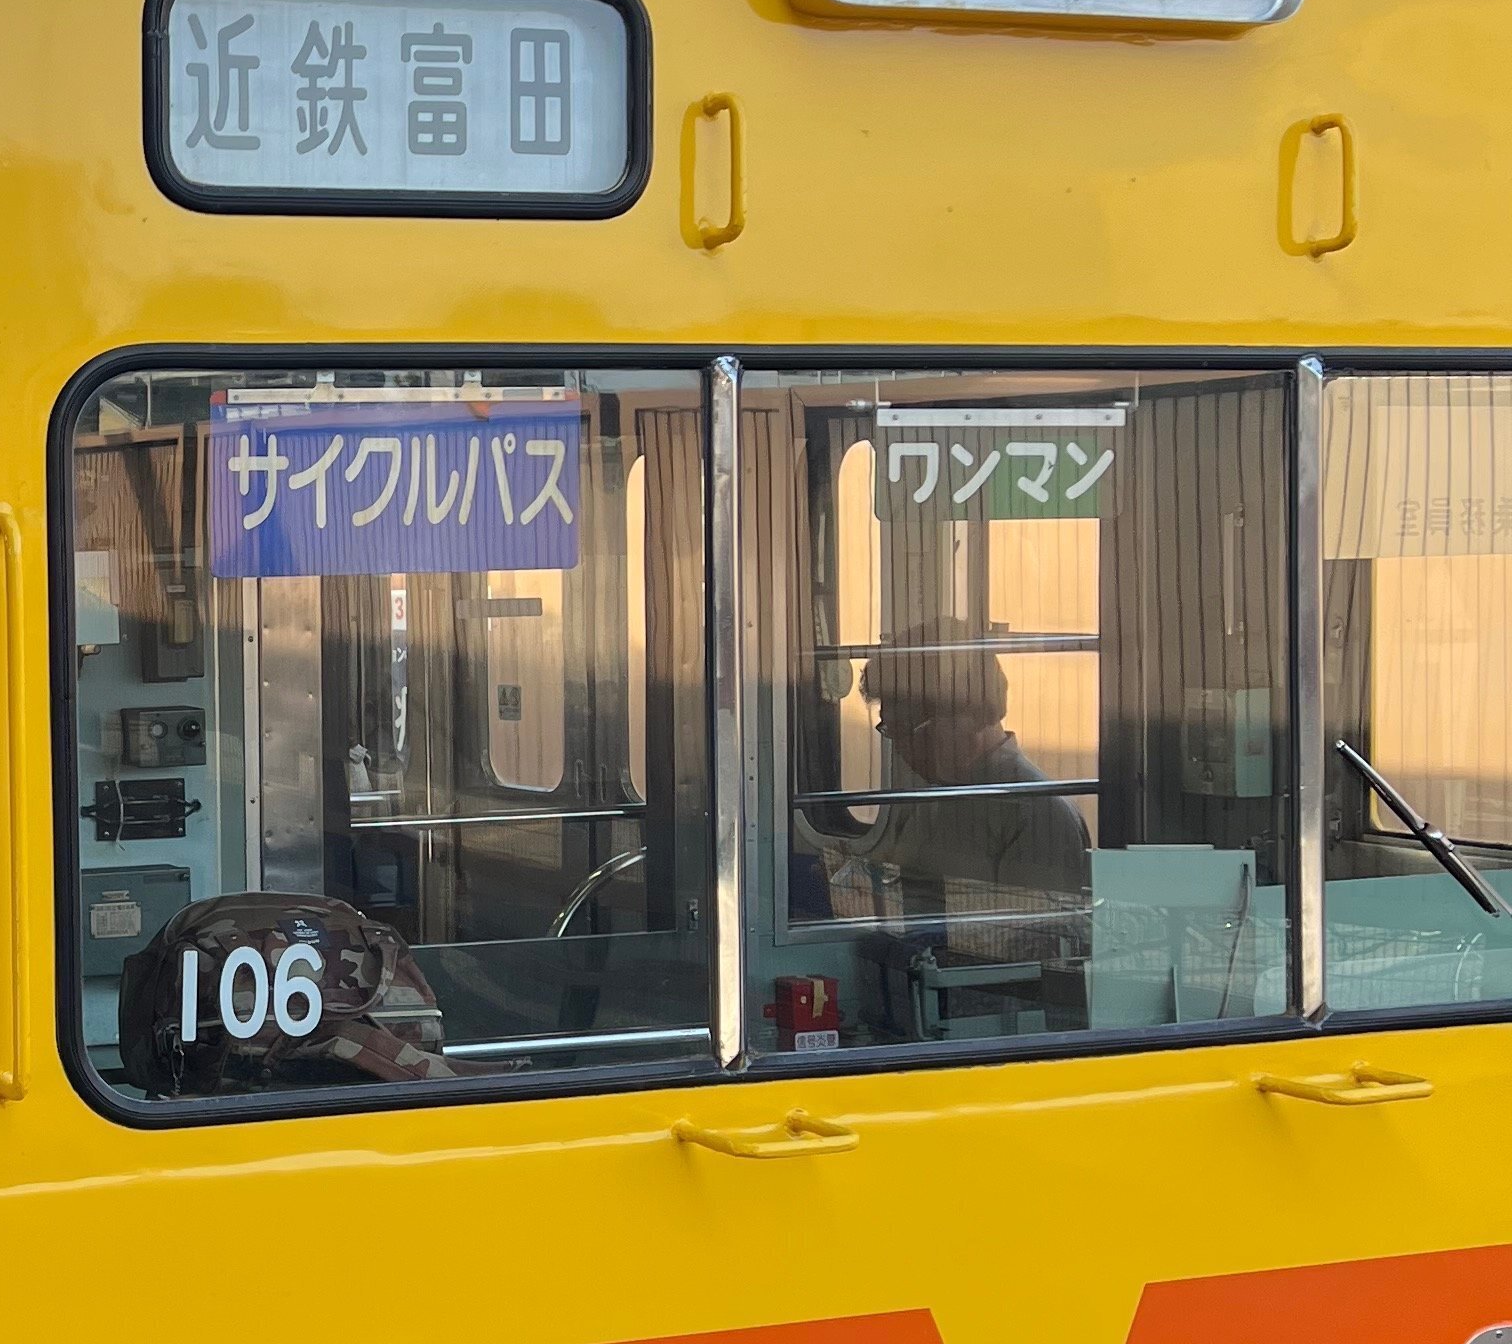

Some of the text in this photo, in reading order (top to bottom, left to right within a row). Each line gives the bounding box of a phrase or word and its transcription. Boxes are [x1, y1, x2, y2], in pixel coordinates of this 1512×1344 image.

[185, 13, 572, 156] 近鉄富田
[227, 432, 575, 530] サイクルパス
[888, 441, 1115, 504] ワンマン
[394, 597, 404, 621] 3
[180, 945, 324, 1043] 106
